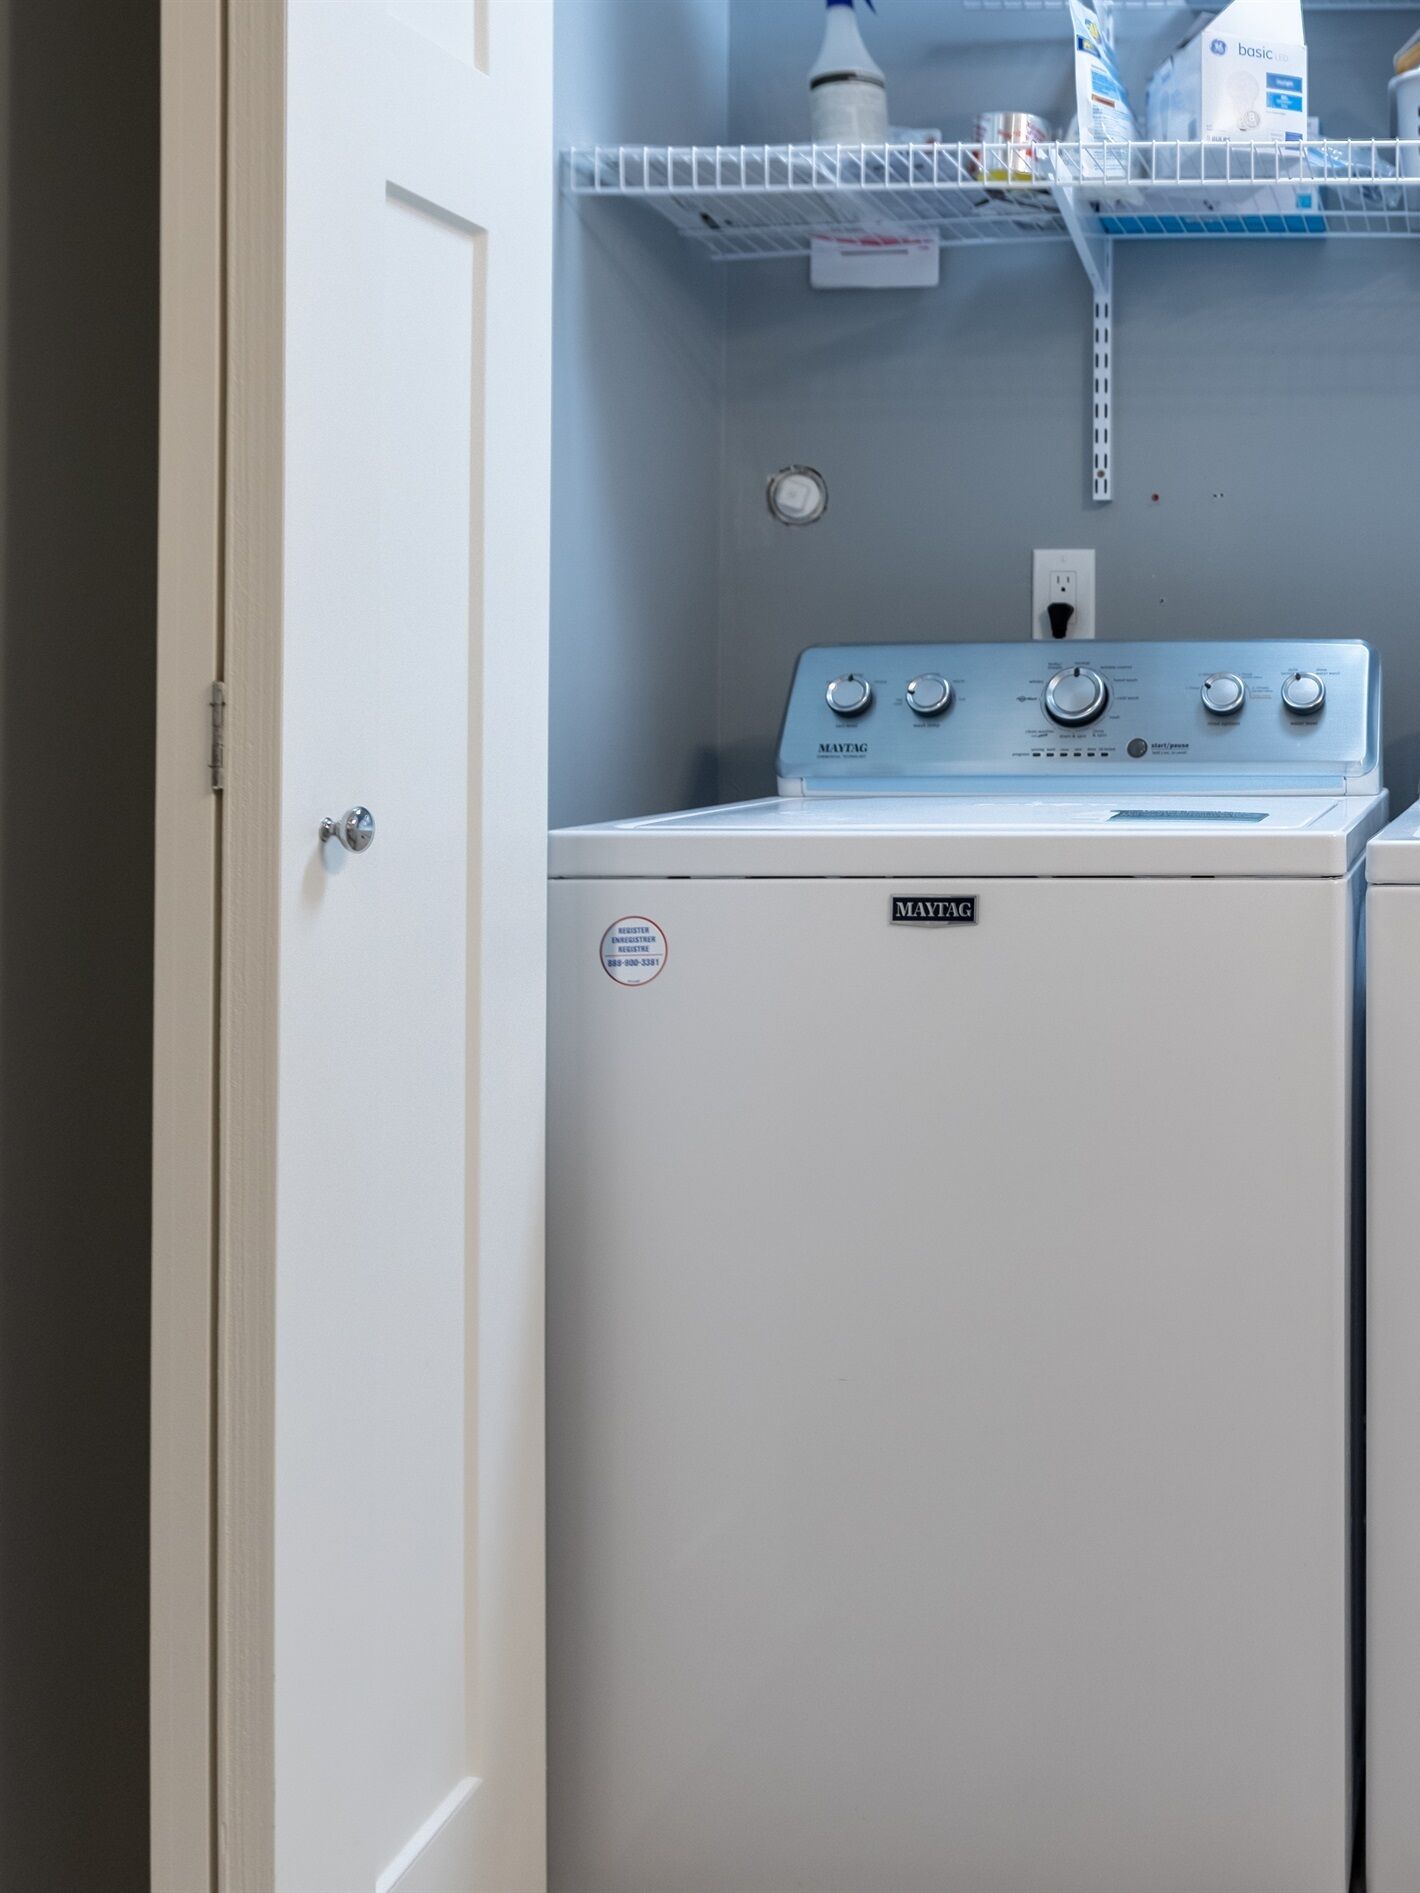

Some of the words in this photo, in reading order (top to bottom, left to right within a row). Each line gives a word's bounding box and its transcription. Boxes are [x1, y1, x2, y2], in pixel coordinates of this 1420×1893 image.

[1239, 42, 1274, 61] basic
[817, 743, 869, 754] MAYTAG
[1151, 743, 1190, 751] start/pause
[896, 901, 973, 918] MAYTAG
[611, 936, 656, 944] ENREGISTRER
